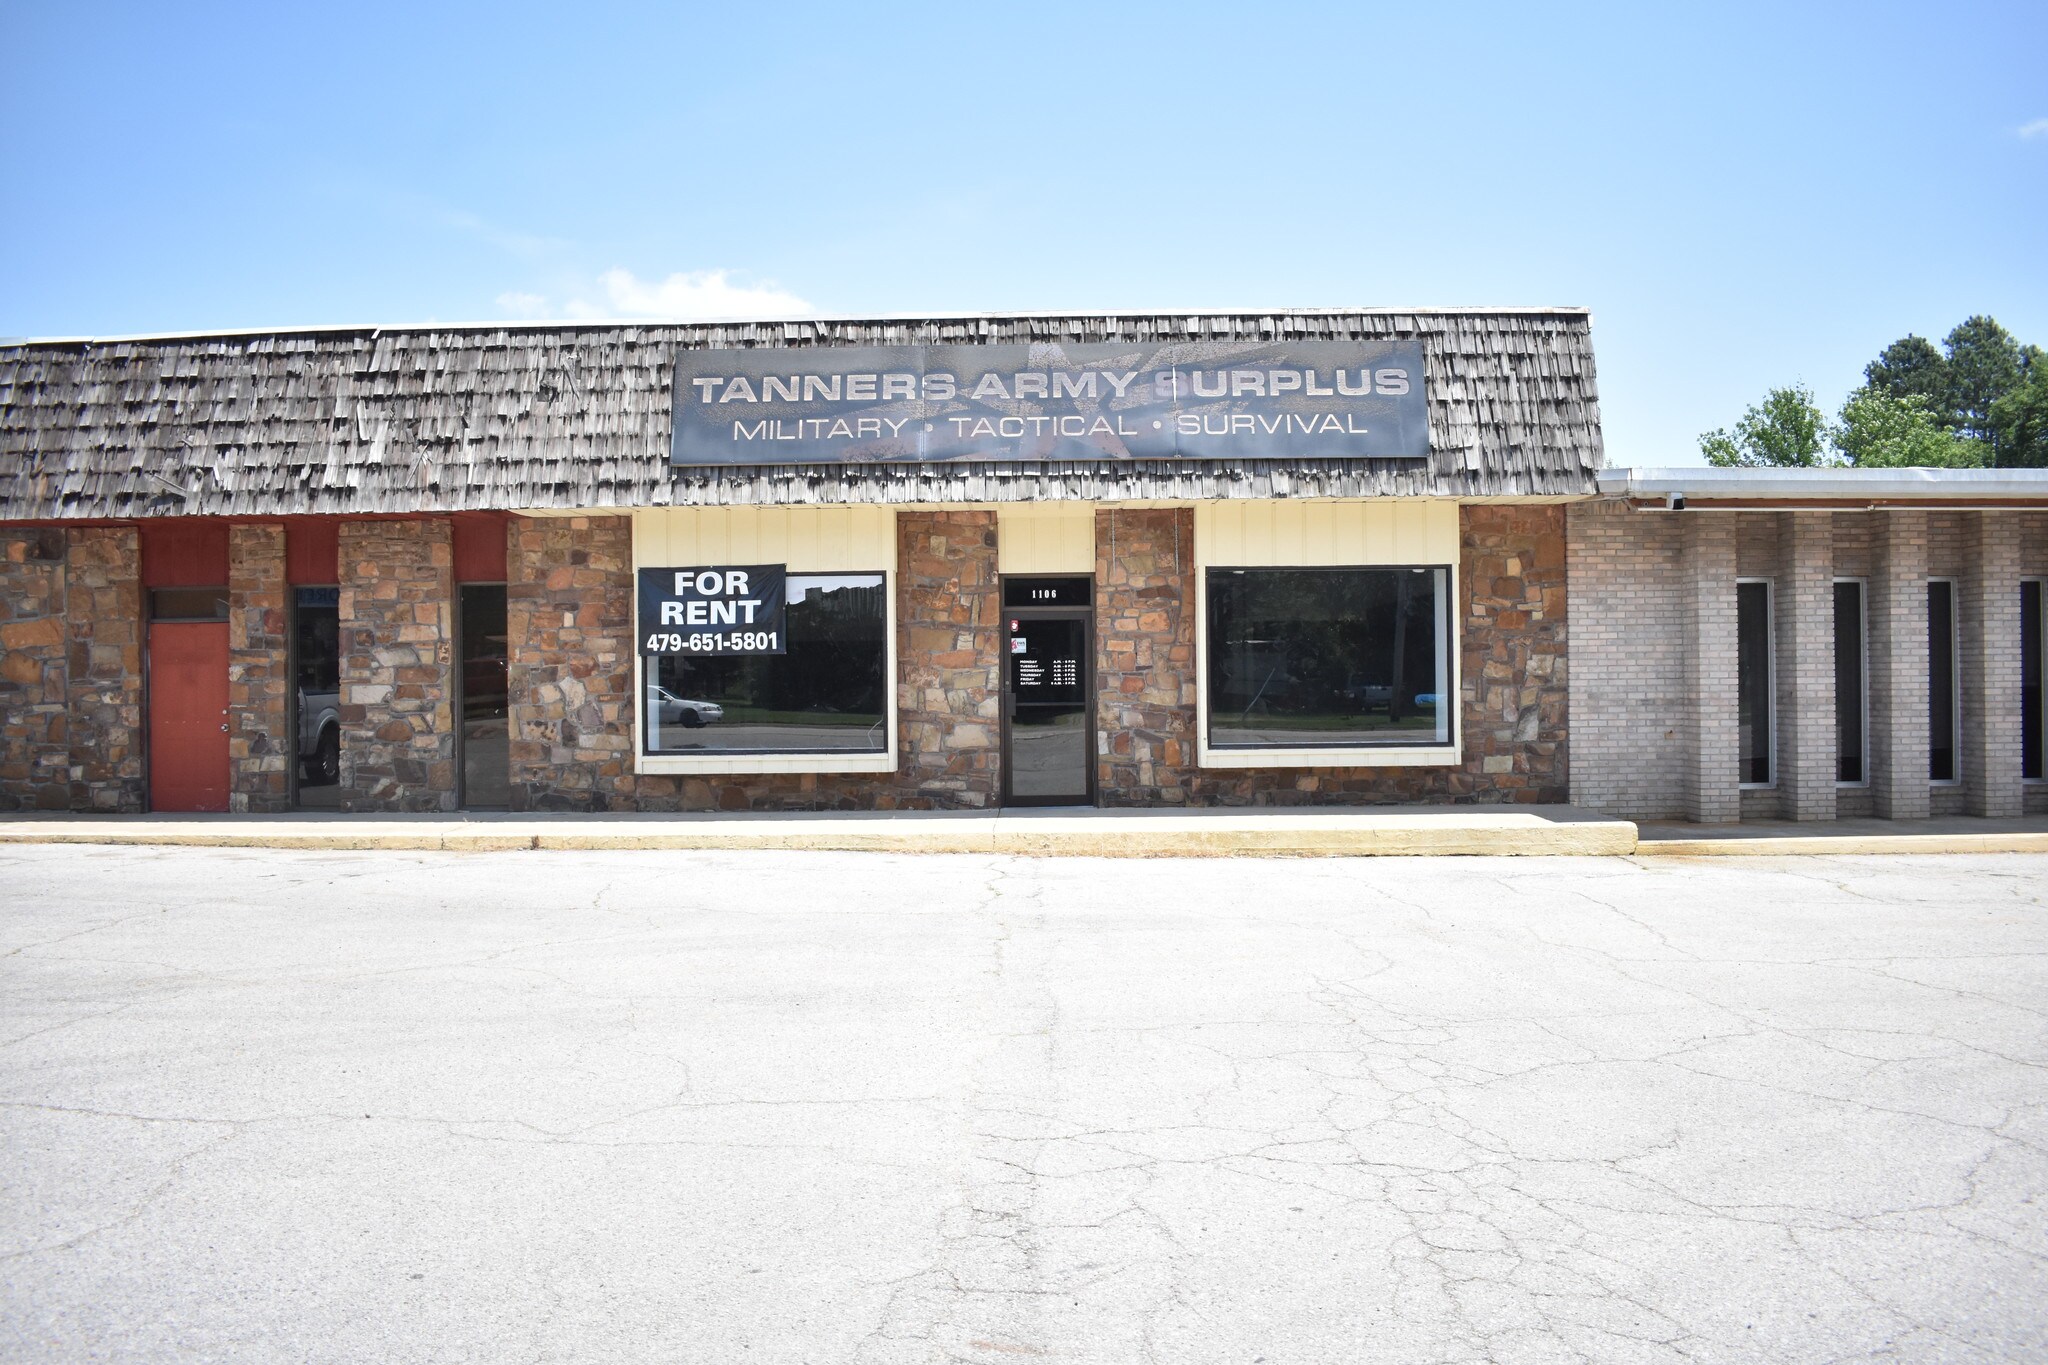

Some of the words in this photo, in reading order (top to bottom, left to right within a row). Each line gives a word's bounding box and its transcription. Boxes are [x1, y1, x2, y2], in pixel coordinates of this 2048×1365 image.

[692, 373, 956, 403] TANNERS
[971, 371, 1138, 400] ARMY
[1154, 368, 1411, 398] SURPLUS
[733, 418, 909, 441] MILITARY
[949, 415, 1138, 438] TACTICAL
[1176, 413, 1369, 434] SURVIVAL
[674, 570, 749, 596] FOR
[1032, 589, 1057, 599] 1106
[660, 600, 762, 625] RENT
[646, 631, 778, 652] 479-651-5801
